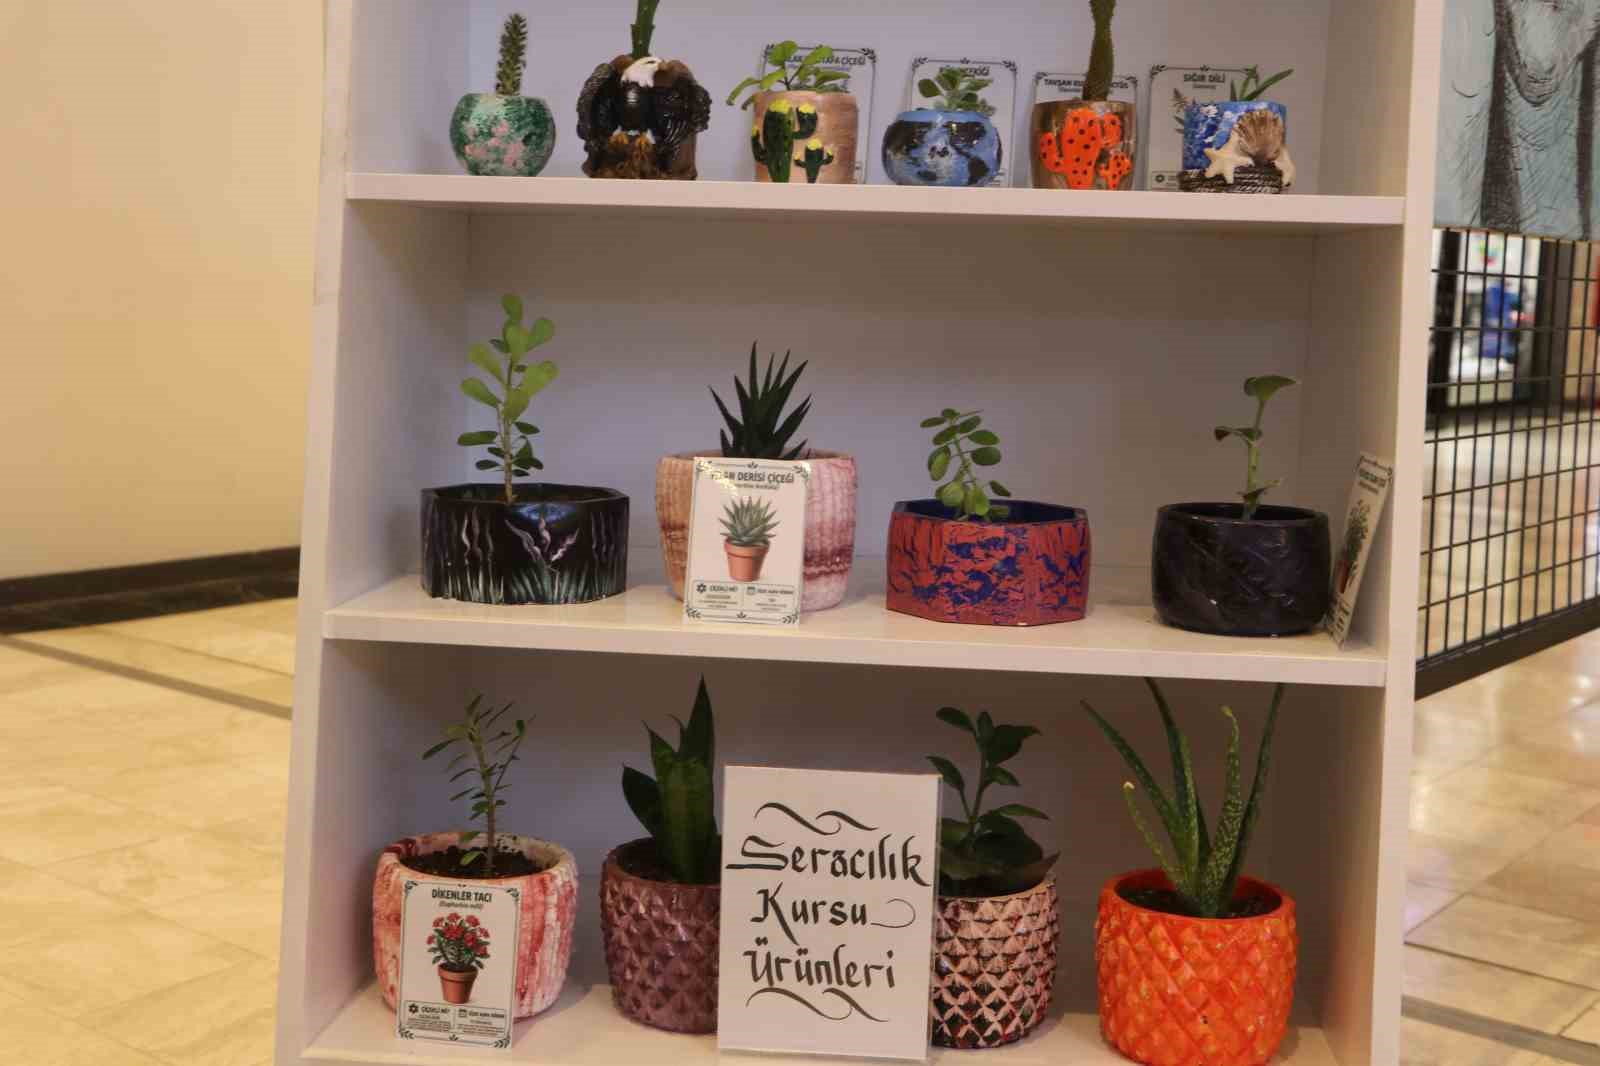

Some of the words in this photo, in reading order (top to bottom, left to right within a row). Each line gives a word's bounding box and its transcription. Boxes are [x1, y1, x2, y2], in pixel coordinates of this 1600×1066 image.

[737, 471, 766, 482] DERİSİ
[767, 473, 795, 484] ÇİÇEĞİ
[725, 833, 931, 886] Seracılık
[431, 888, 472, 901] DİKENLER
[750, 881, 867, 945] Kursu
[743, 936, 895, 988] Ürünleri
